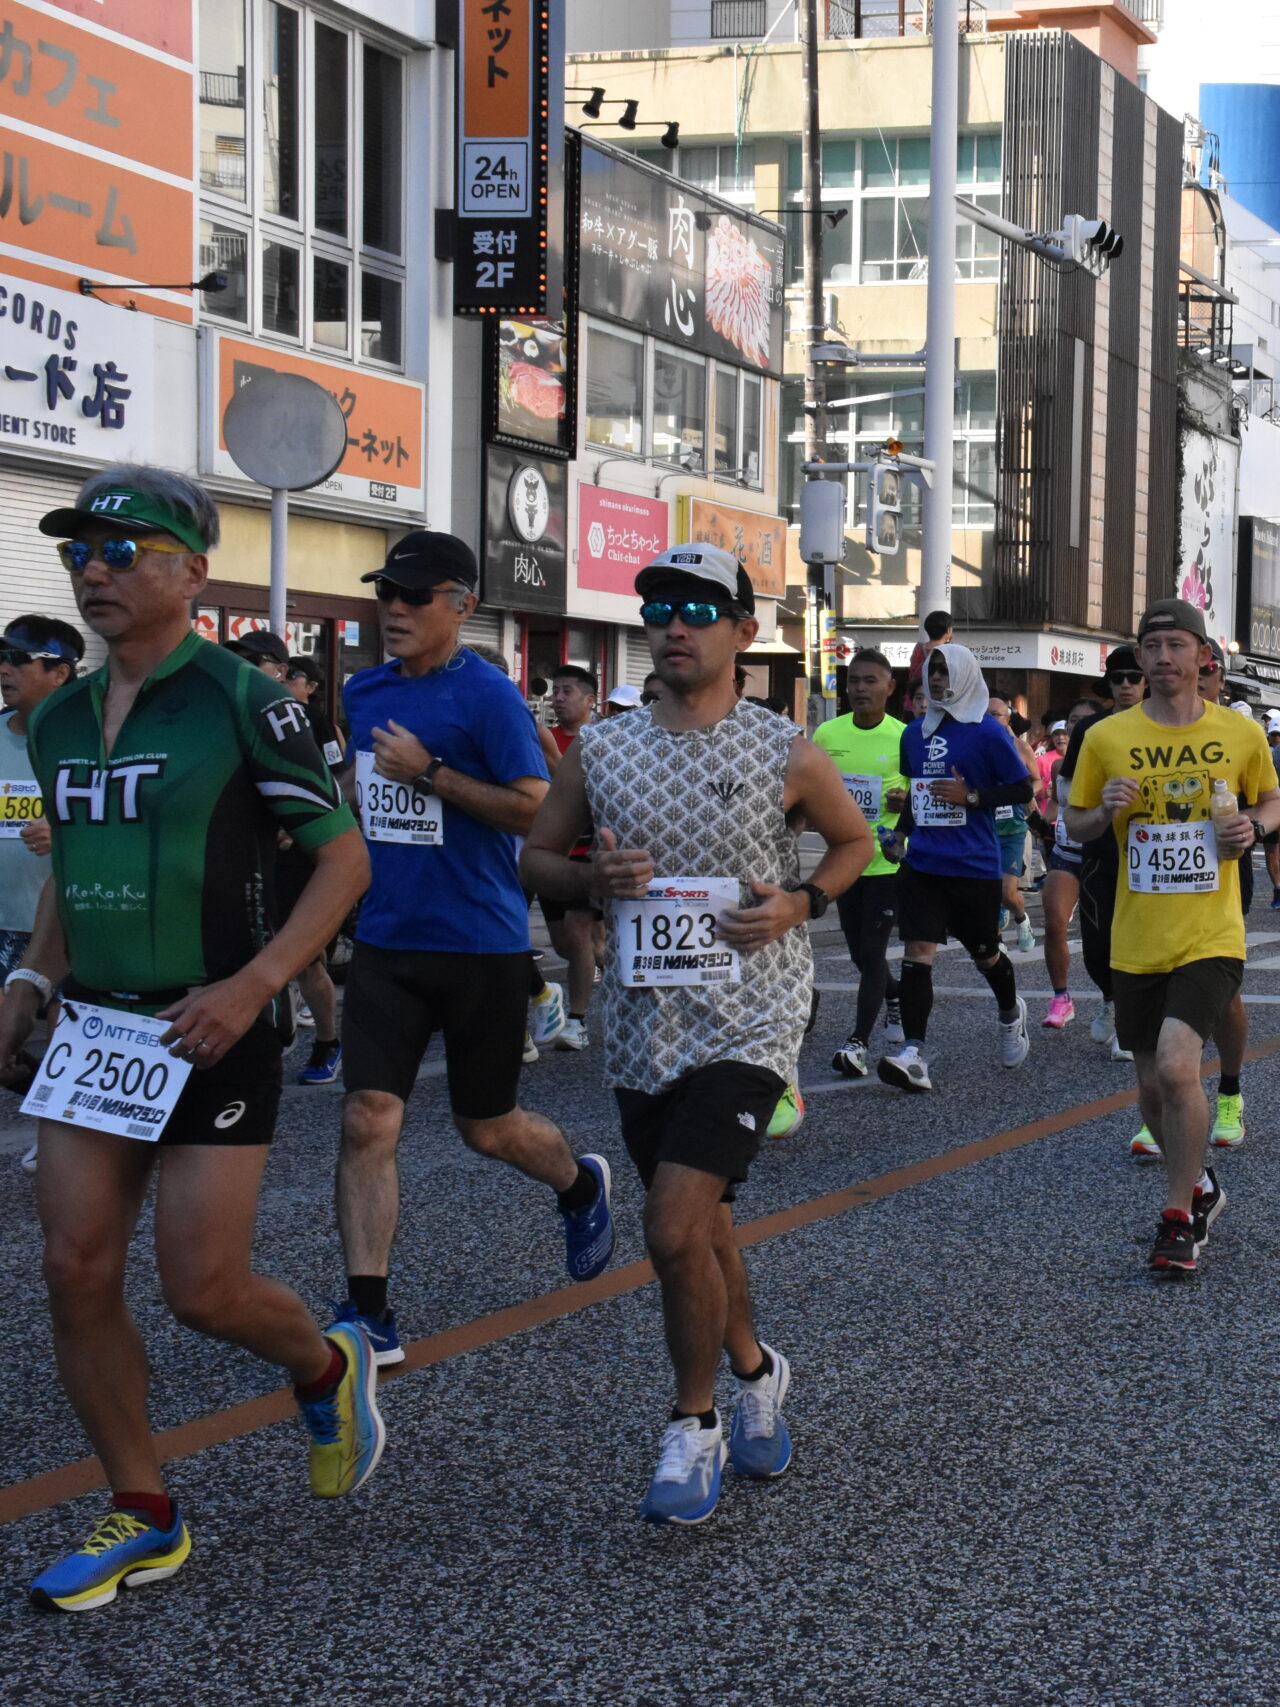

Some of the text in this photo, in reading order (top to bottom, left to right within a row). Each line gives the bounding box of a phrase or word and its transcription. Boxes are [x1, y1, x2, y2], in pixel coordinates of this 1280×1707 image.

[0, 19, 121, 129] カフェ
[474, 156, 518, 182] 24h
[0, 151, 139, 256] ルーム
[471, 184, 520, 199] OPEN
[472, 230, 518, 256] 受付
[475, 261, 516, 288] 2F
[664, 195, 697, 337] 肉心
[0, 413, 77, 445] ENT STORE
[90, 494, 132, 512] HT
[370, 483, 397, 498] 受付 2F
[606, 524, 661, 555] ちっとちゃっと
[514, 552, 544, 587] 肉心
[607, 549, 641, 565] Chit-chat
[979, 654, 1006, 662] Service
[922, 761, 946, 770] POWER
[1129, 741, 1231, 771] SWAG.
[56, 764, 160, 822] HT
[368, 783, 426, 816] 3506
[912, 795, 918, 811] C
[4, 796, 45, 820] 580
[1151, 829, 1206, 843] 琉球銀行
[1129, 845, 1206, 872] D 4526
[664, 886, 710, 898] SPORTS
[630, 912, 718, 951] 1823
[632, 951, 733, 970] 第39回 NAHAマラソン
[104, 1023, 174, 1050] NTT西日
[45, 1042, 169, 1101] C 2500
